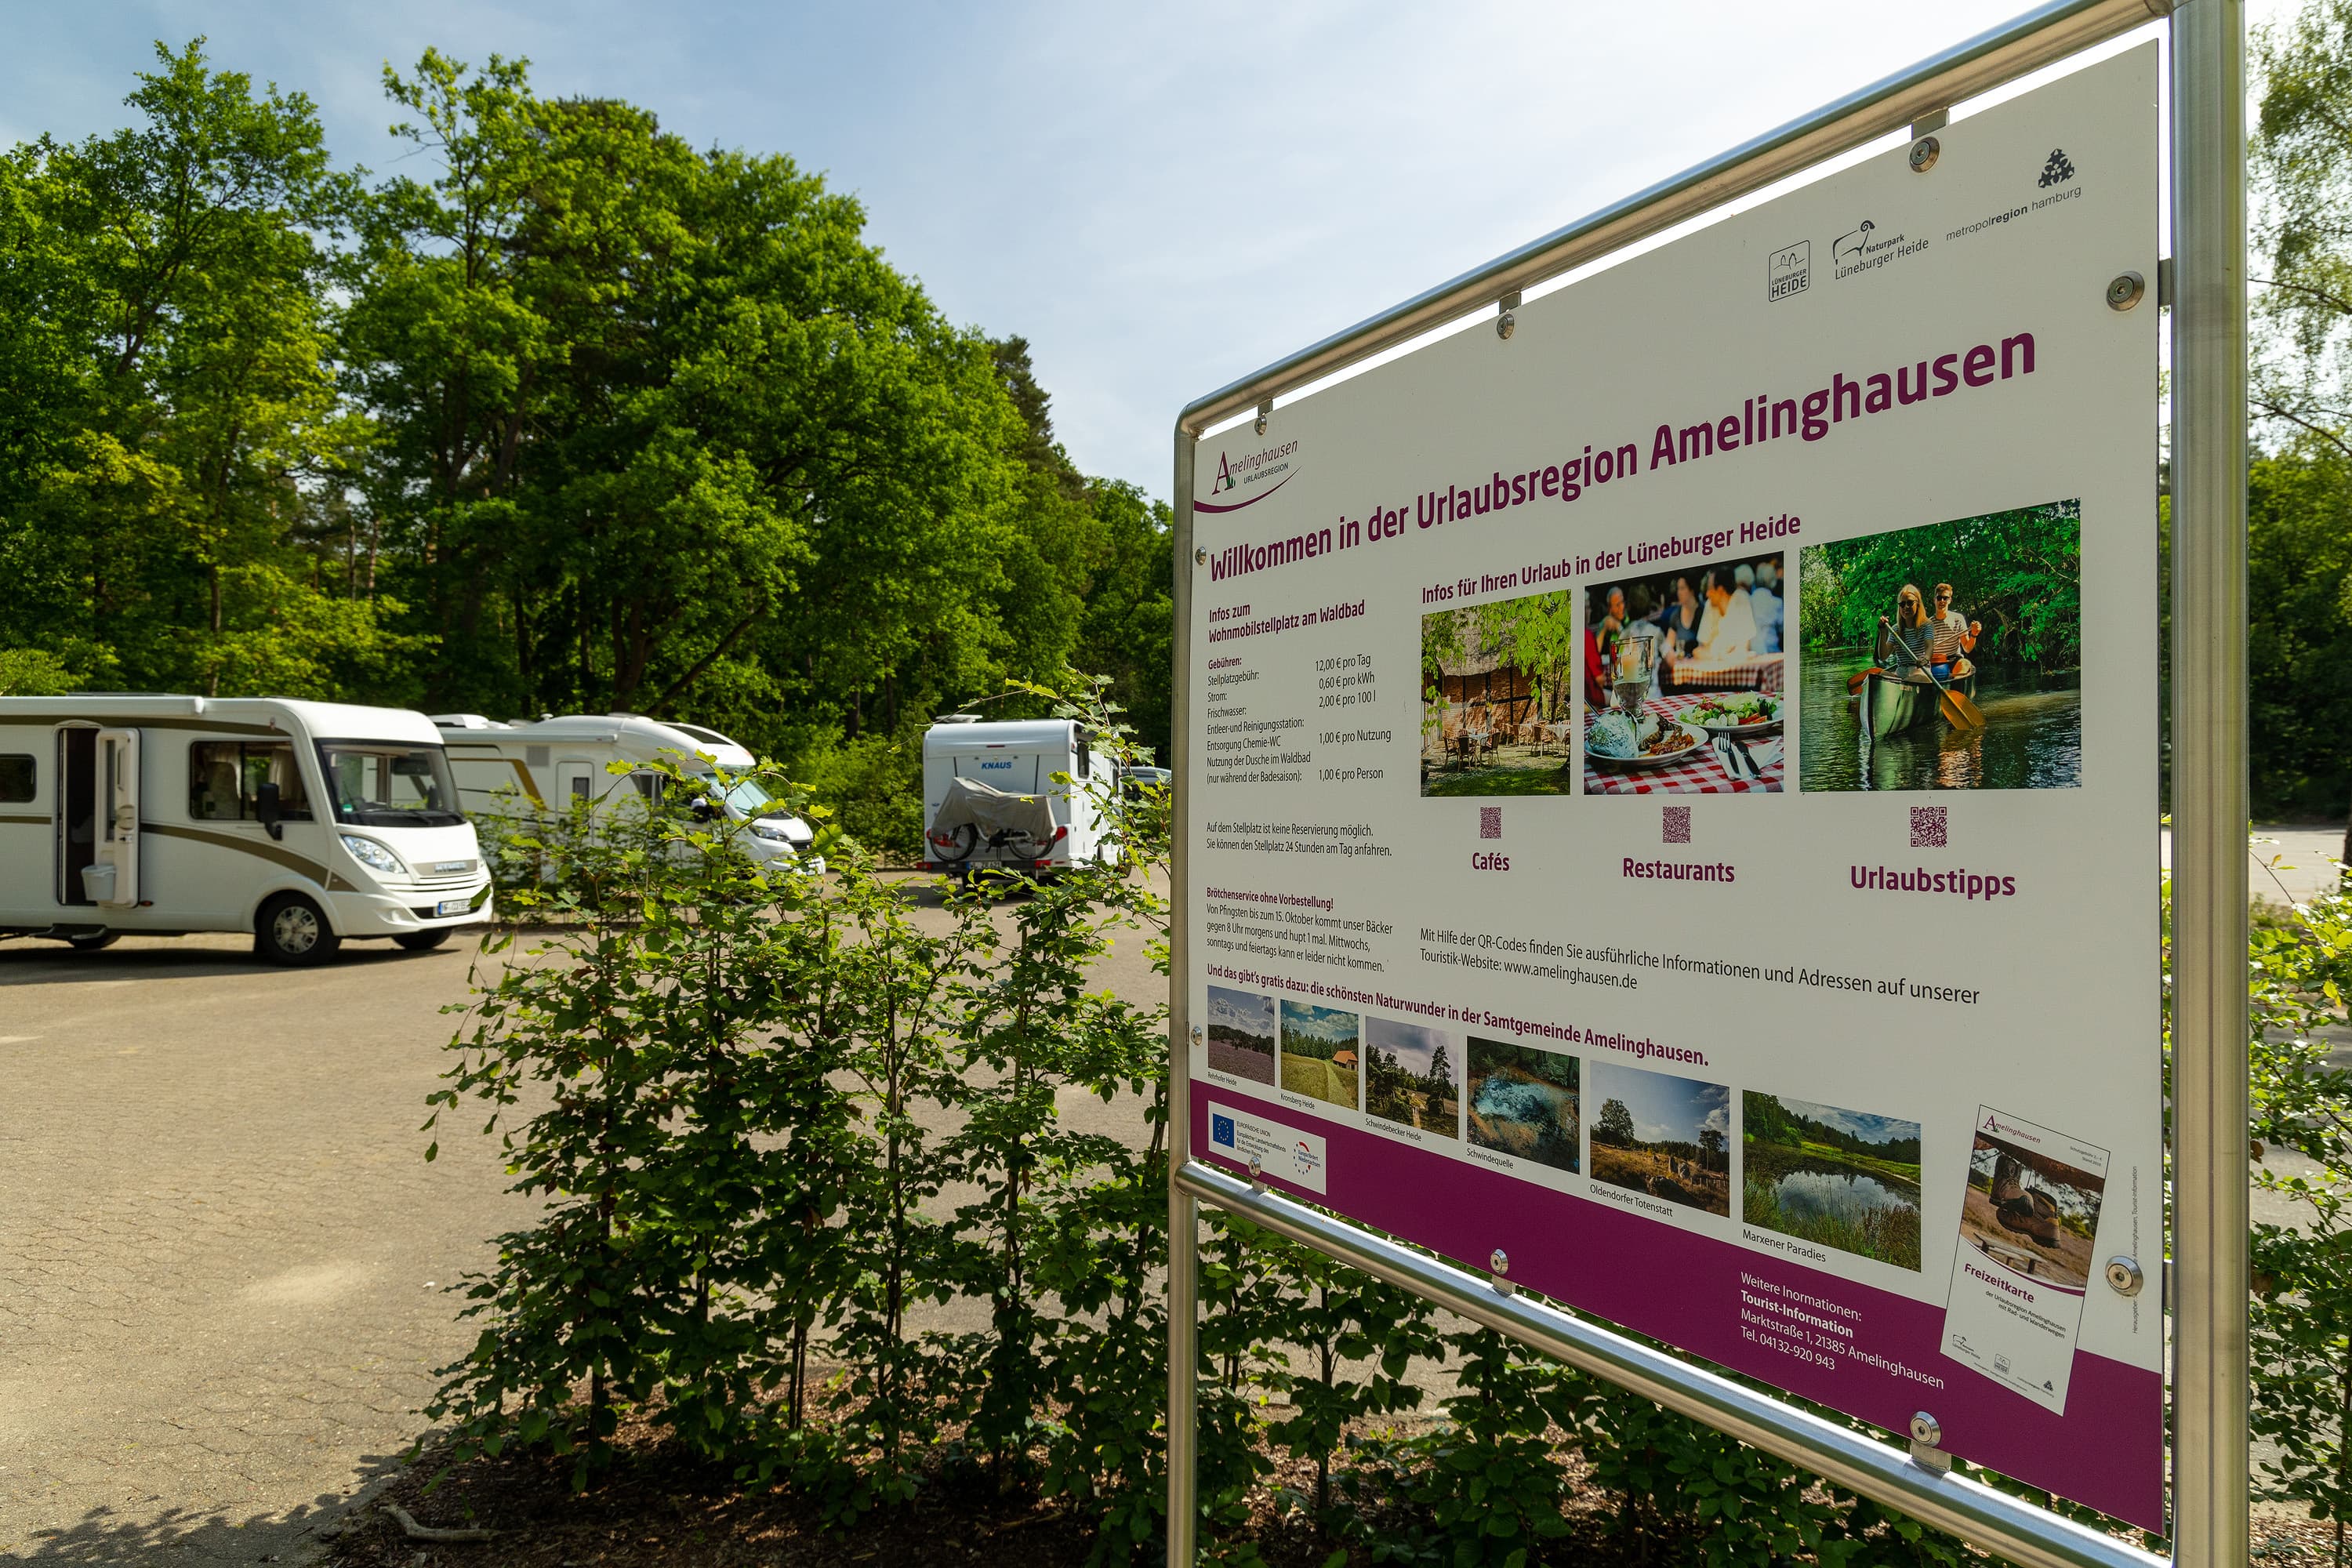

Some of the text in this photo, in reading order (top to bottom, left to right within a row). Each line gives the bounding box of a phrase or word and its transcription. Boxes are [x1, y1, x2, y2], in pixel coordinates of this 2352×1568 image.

[1946, 187, 2081, 241] metropolregion hamburg
[1865, 234, 1905, 255] Naturpark
[1835, 238, 1929, 280] Lüneburger Heide
[1771, 268, 1807, 286] LÜNEBURGER
[1771, 274, 1808, 299] HEIDE
[1210, 332, 2034, 581] Willkommen in der Urlaubsregion Amelinghausen
[1210, 439, 1298, 495] Amelinghausen
[1243, 462, 1288, 484] URLAUBSREGION
[1422, 513, 1800, 604] Infos für Ihren Urlaub in der Lüneburger Heide
[1208, 599, 1364, 643] Wohnmobilstellplatz am Waldbad
[1209, 604, 1250, 622] Infos zum
[1207, 656, 1242, 670] Gebühren:
[1315, 654, 1371, 672] 12,00 € pro Tag
[1207, 669, 1259, 687] Stellplatzgebühr:
[1207, 691, 1227, 702] Strom:
[1207, 706, 1247, 718] Frischwasser:
[1243, 717, 1304, 733] Reinigungsstation:
[1319, 729, 1391, 745] 1,00 € pro Nutzung
[1207, 735, 1281, 752] Entsorgung Chemie-WC
[981, 761, 1012, 770] KNAUS
[1207, 750, 1311, 768] Nutzung der Dusche im Waldbad
[1207, 769, 1301, 784] (nur während der Badesaison):
[1206, 821, 1218, 832] Auf
[1218, 822, 1232, 833] dem
[1232, 822, 1261, 836] Stellplatz
[1272, 822, 1290, 834] keine
[1291, 822, 1338, 838] Reservierung
[1340, 823, 1373, 839] möglich.
[1206, 837, 1392, 858] Sie können den Stellplatz 24 Stunden am Tag anfahren.
[1472, 851, 1509, 871] Cafés
[1623, 857, 1734, 882] Restaurants
[1850, 866, 2016, 900] Urlaubstipps
[1207, 887, 1333, 912] Brötchenservice ohne Vorbestellung!
[1206, 902, 1392, 934] Von Pfingsten bis zum 15. Oktober kommt unser Bäcker
[1207, 922, 1370, 953] gegen 8 Uhr morgens und hupt 1 mal. Mittwochs,
[1207, 938, 1384, 972] sonntags und feiertags kann er leider nicht kommen.
[1420, 927, 1980, 1004] Mit Hilfe der QR-Codes finden Sie ausführliche Informationen und Adressen auf unserer
[1419, 948, 1637, 989] Touristik-Website: www.amelinghausen.de
[1207, 963, 1222, 977] Und
[1223, 965, 1236, 979] das
[1261, 975, 1283, 988] gratis
[1285, 976, 1308, 993] dazu:
[1310, 981, 1324, 995] die
[1326, 984, 1373, 1004] schönsten
[1376, 992, 1446, 1018] Naturwunder
[1448, 1004, 1458, 1020] in
[1461, 1007, 1481, 1024] der
[1483, 1011, 1581, 1043] Samtgemeinde
[1584, 1028, 1708, 1066] Amelinghausen.
[1280, 1092, 1315, 1109] Kronsberg Heide
[1365, 1117, 1421, 1142] Schwindebecker Heide
[1982, 1115, 2042, 1144] Amelinghausen
[1466, 1147, 1513, 1169] Schwindequelle
[1589, 1184, 1673, 1217] Oldendorfer Totenstatt
[1742, 1229, 1826, 1261] Marxener Paradies
[1964, 1262, 2035, 1304] Freizeitkarte
[1740, 1271, 1861, 1321] Weitere Inormationen:
[1740, 1289, 1853, 1338] Tourist-Information
[1740, 1325, 1835, 1370] Tel. 04132-920 943
[1740, 1308, 1803, 1340] Marktstraße
[1806, 1330, 1813, 1345] 1,
[1815, 1334, 1845, 1354] 21385
[1848, 1345, 1944, 1389] Amelinghausen
